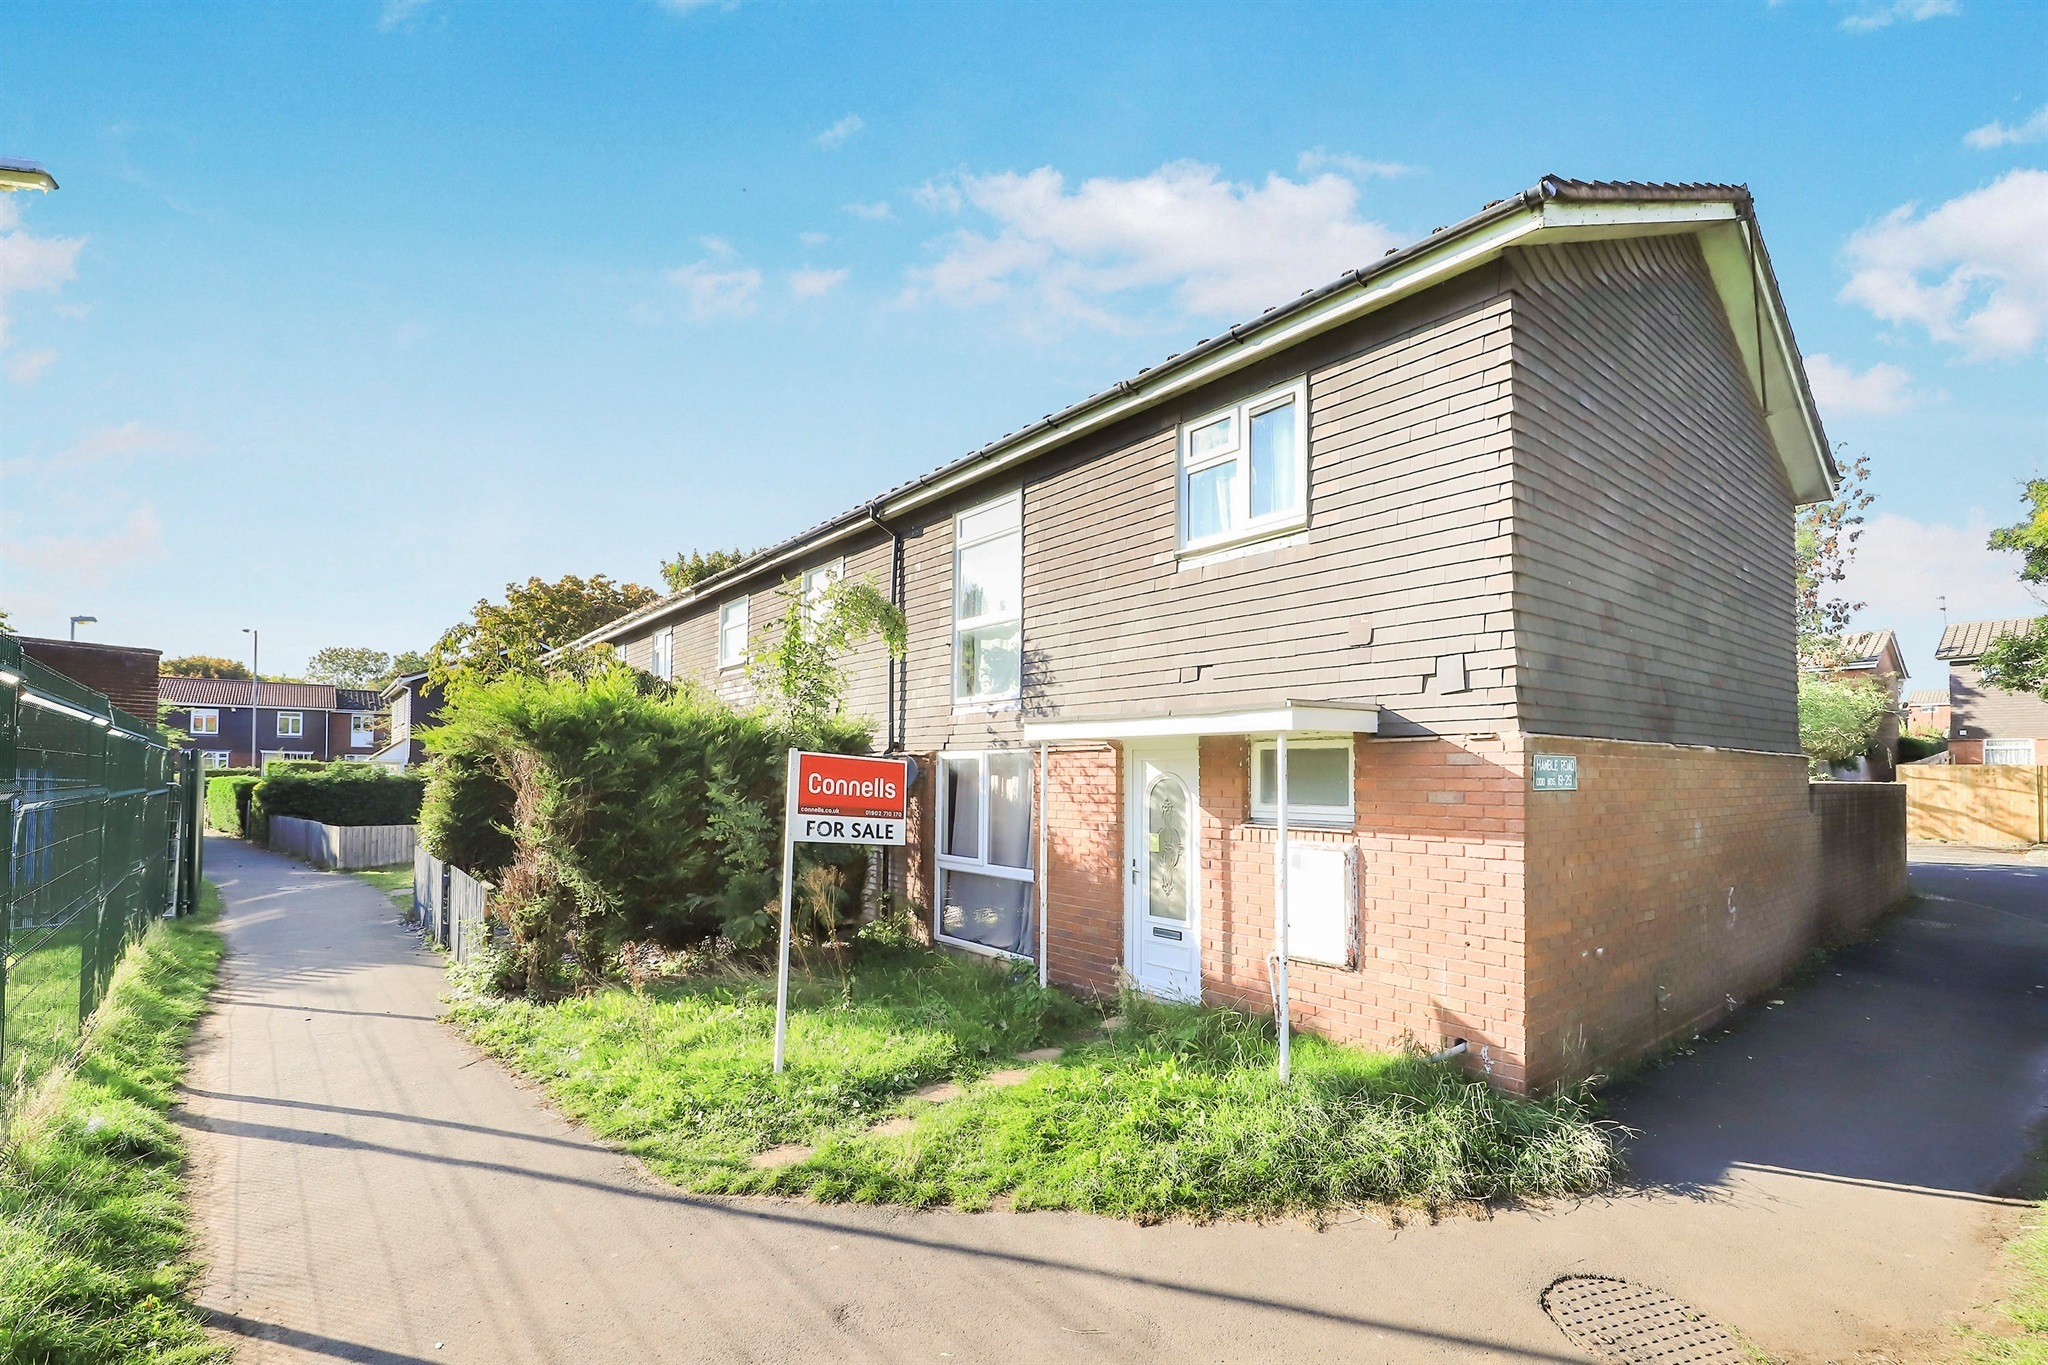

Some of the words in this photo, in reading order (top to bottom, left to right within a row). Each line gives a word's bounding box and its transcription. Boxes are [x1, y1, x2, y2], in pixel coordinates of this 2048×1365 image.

[1537, 759, 1558, 771] HAMBLE
[1561, 760, 1575, 771] ROAD
[808, 772, 897, 799] Connells
[800, 806, 840, 815] connells.co.uk
[806, 820, 845, 838] FOR
[851, 823, 894, 840] SALE
